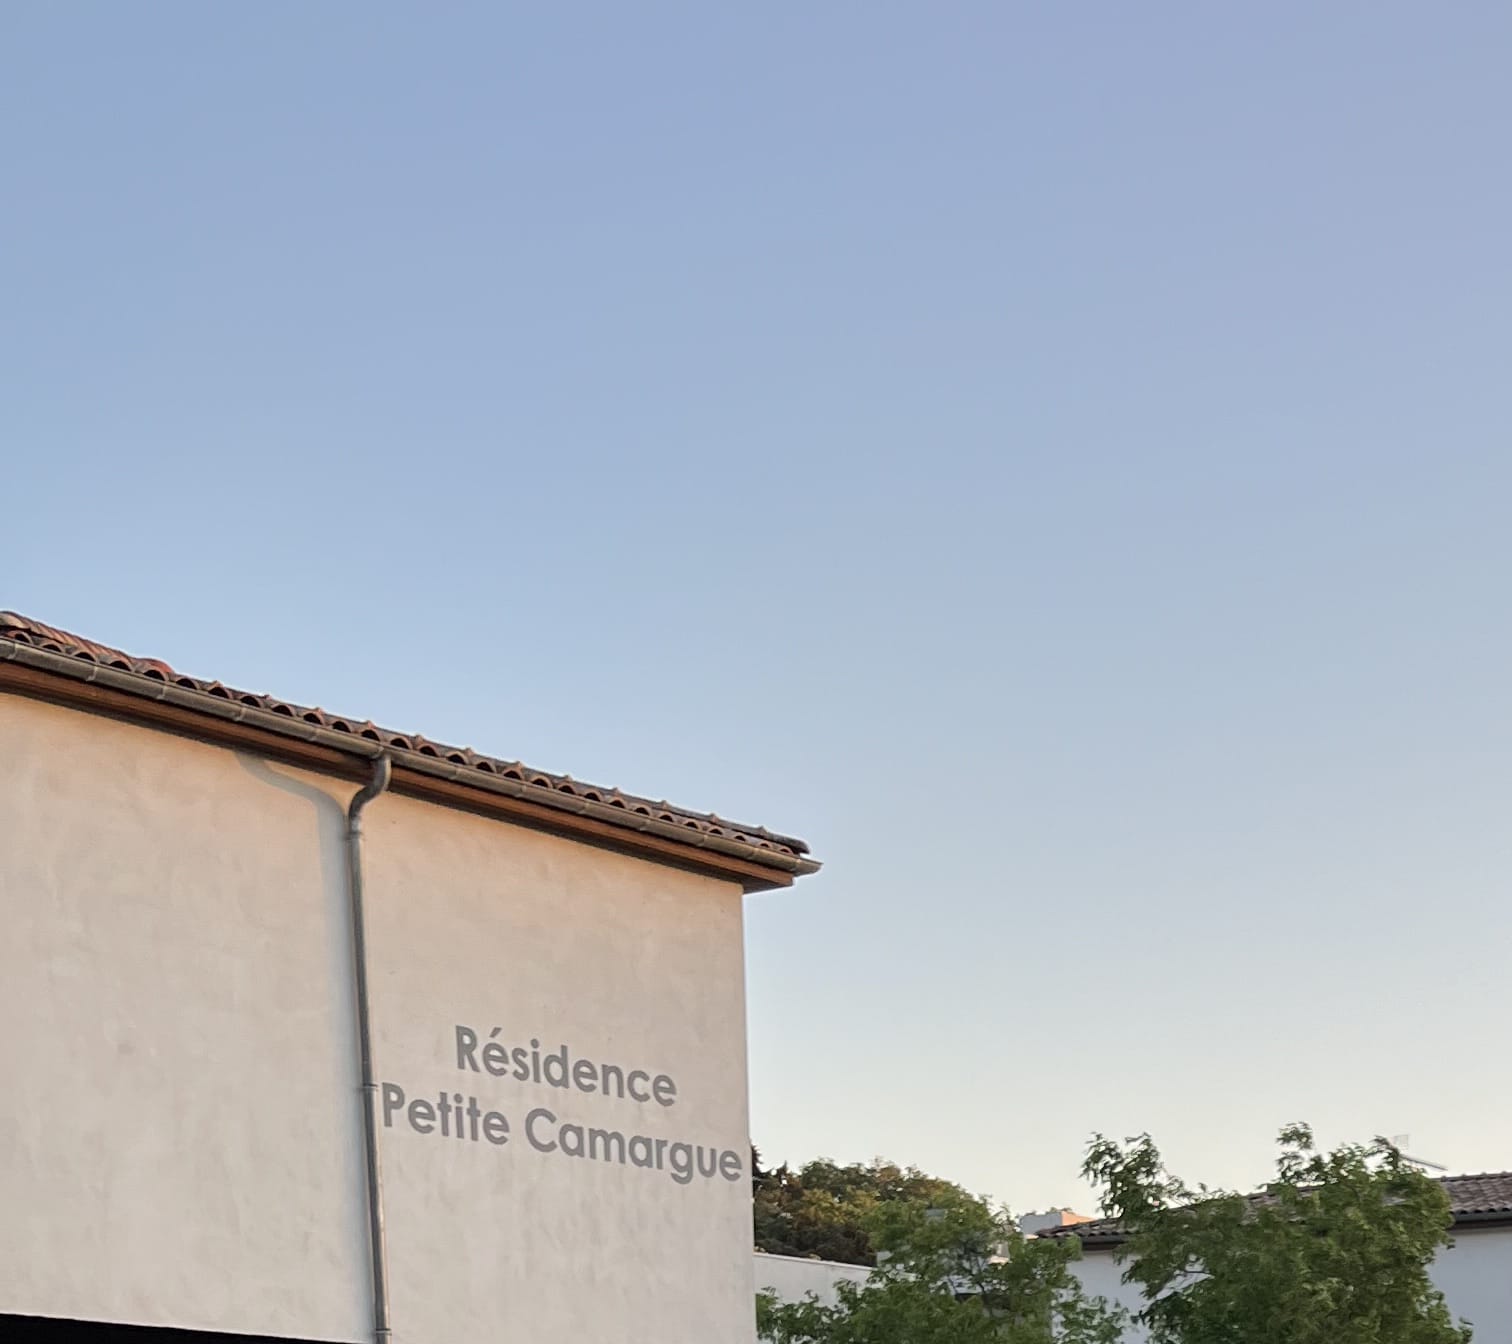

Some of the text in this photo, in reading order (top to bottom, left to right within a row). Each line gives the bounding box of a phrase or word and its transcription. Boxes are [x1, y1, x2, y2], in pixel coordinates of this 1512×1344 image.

[455, 1025, 676, 1107] Résidence
[381, 1082, 742, 1184] Petite Camargue
